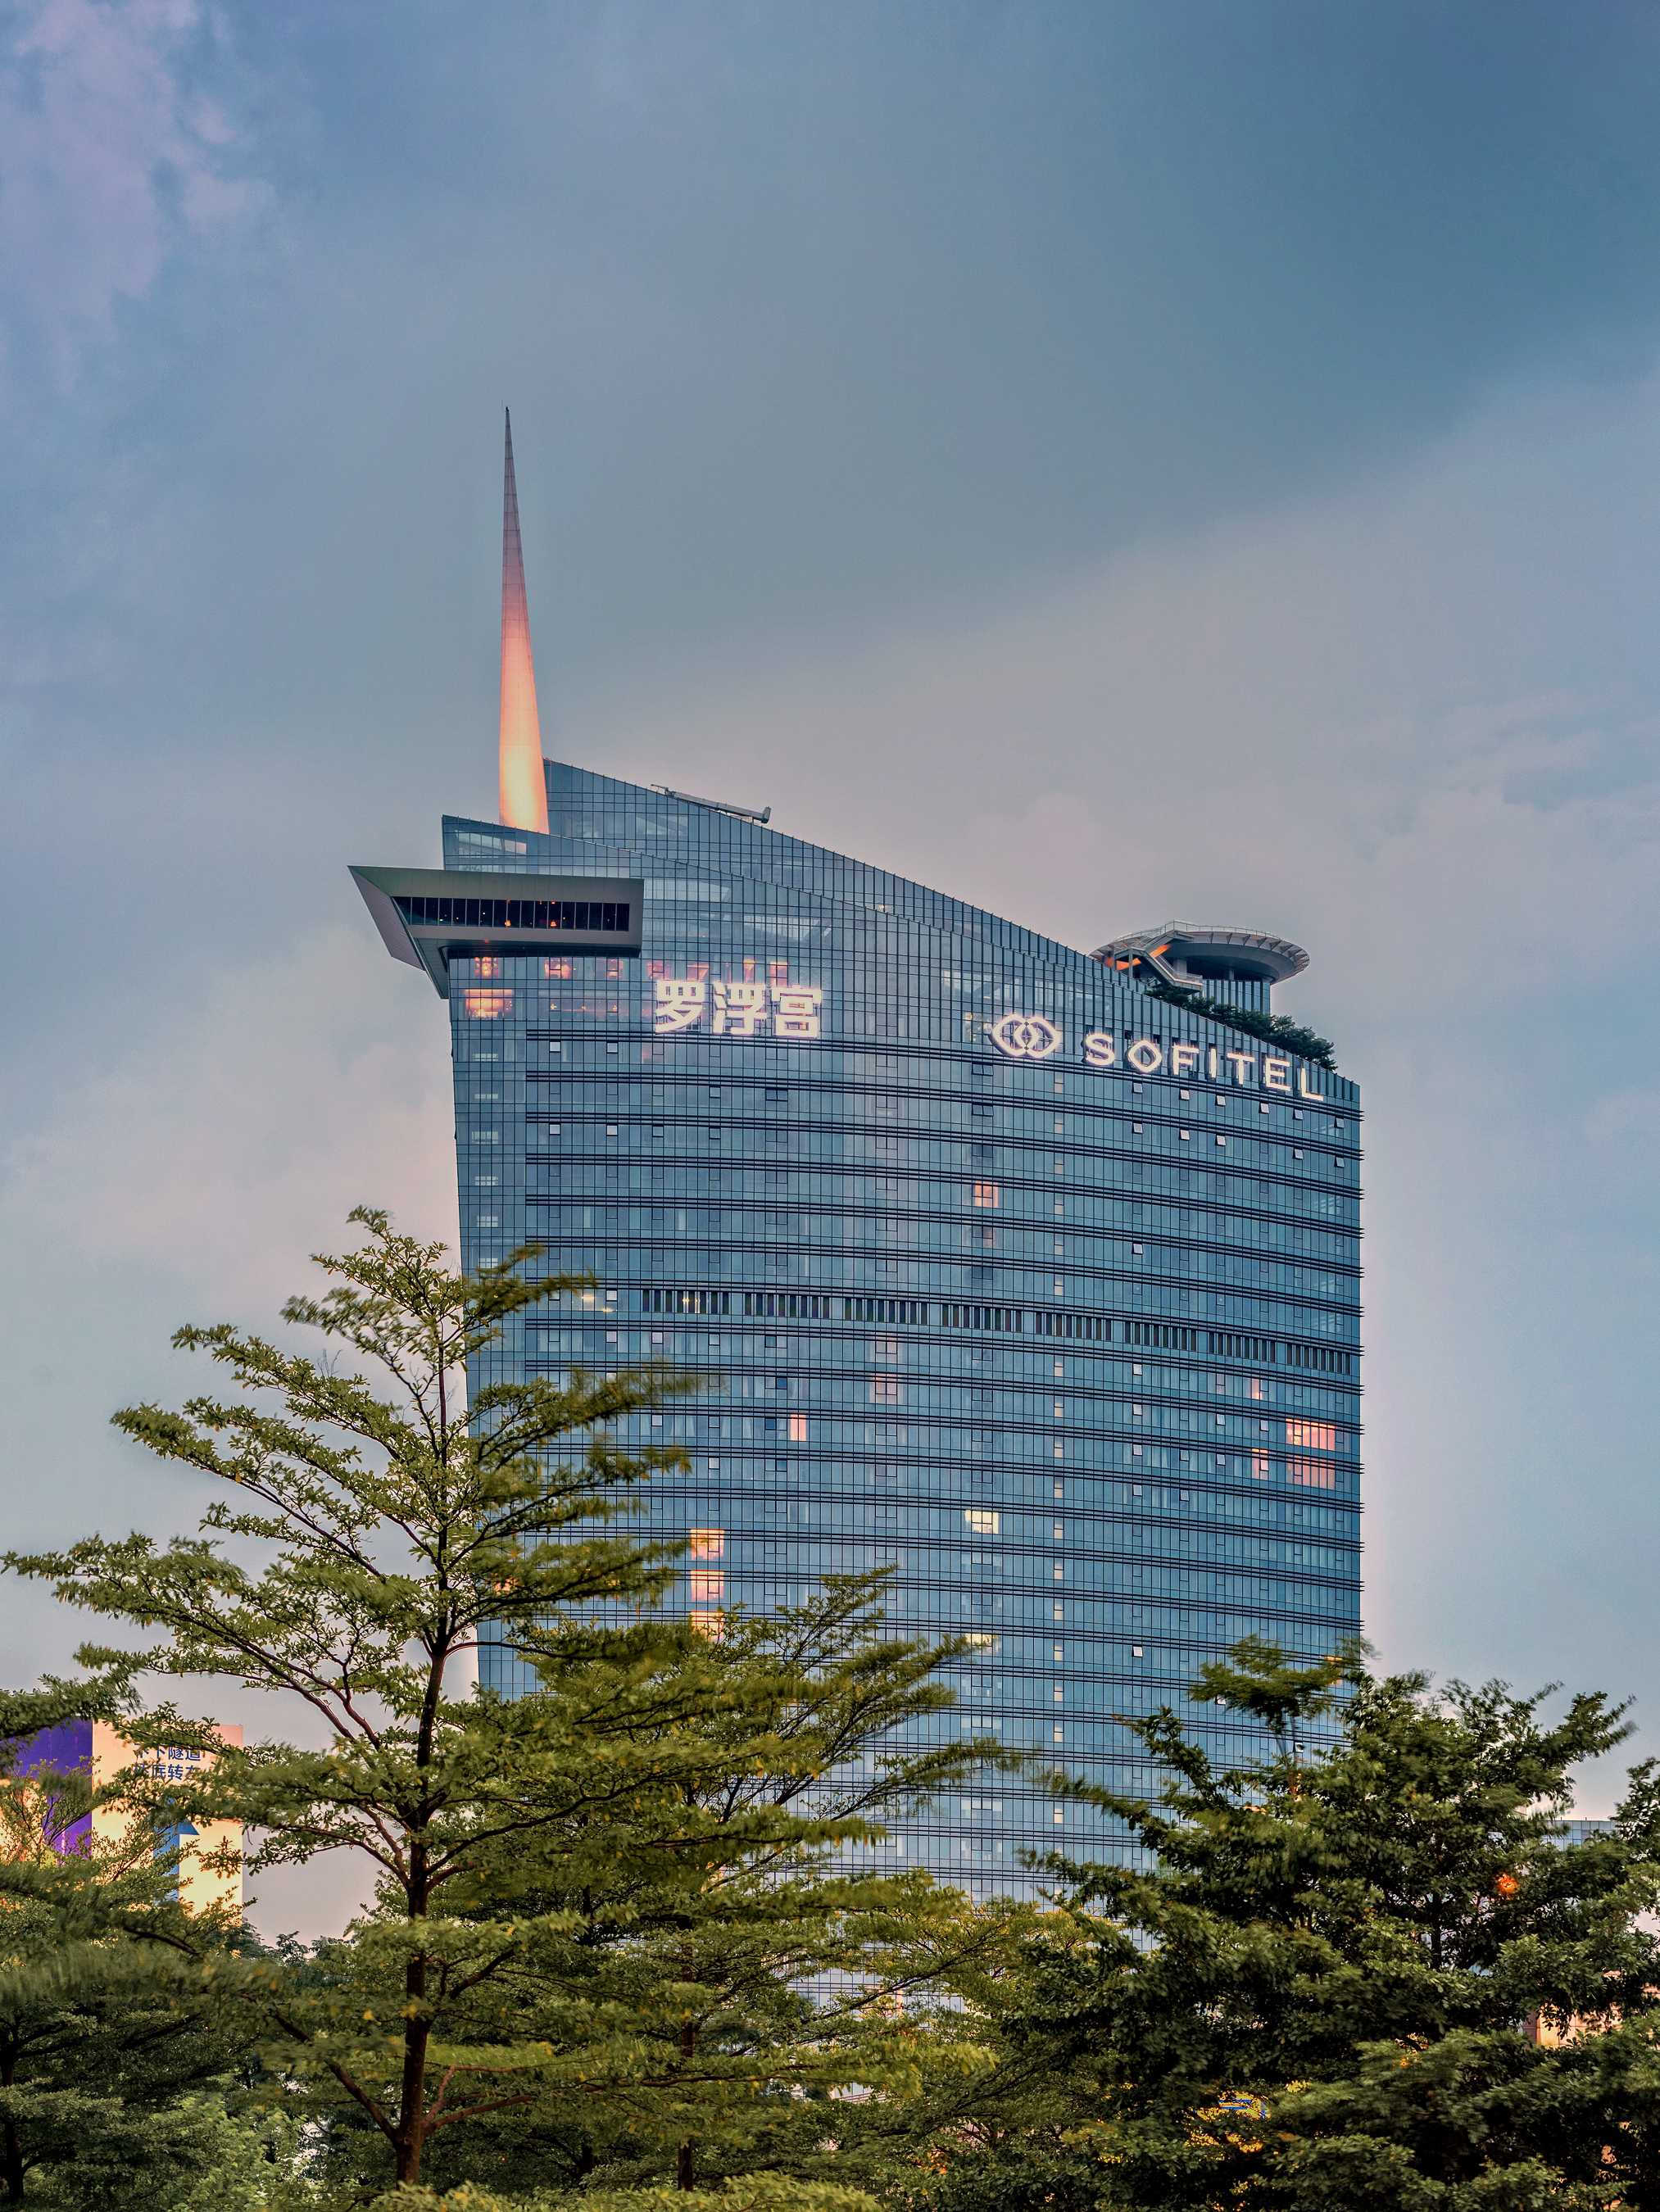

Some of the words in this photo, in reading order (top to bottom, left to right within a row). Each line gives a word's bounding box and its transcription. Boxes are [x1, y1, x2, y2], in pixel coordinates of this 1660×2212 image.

[655, 980, 822, 1038] 罗浮宫
[1084, 1032, 1324, 1101] SOFITEL
[134, 1763, 201, 1780] 底转左
